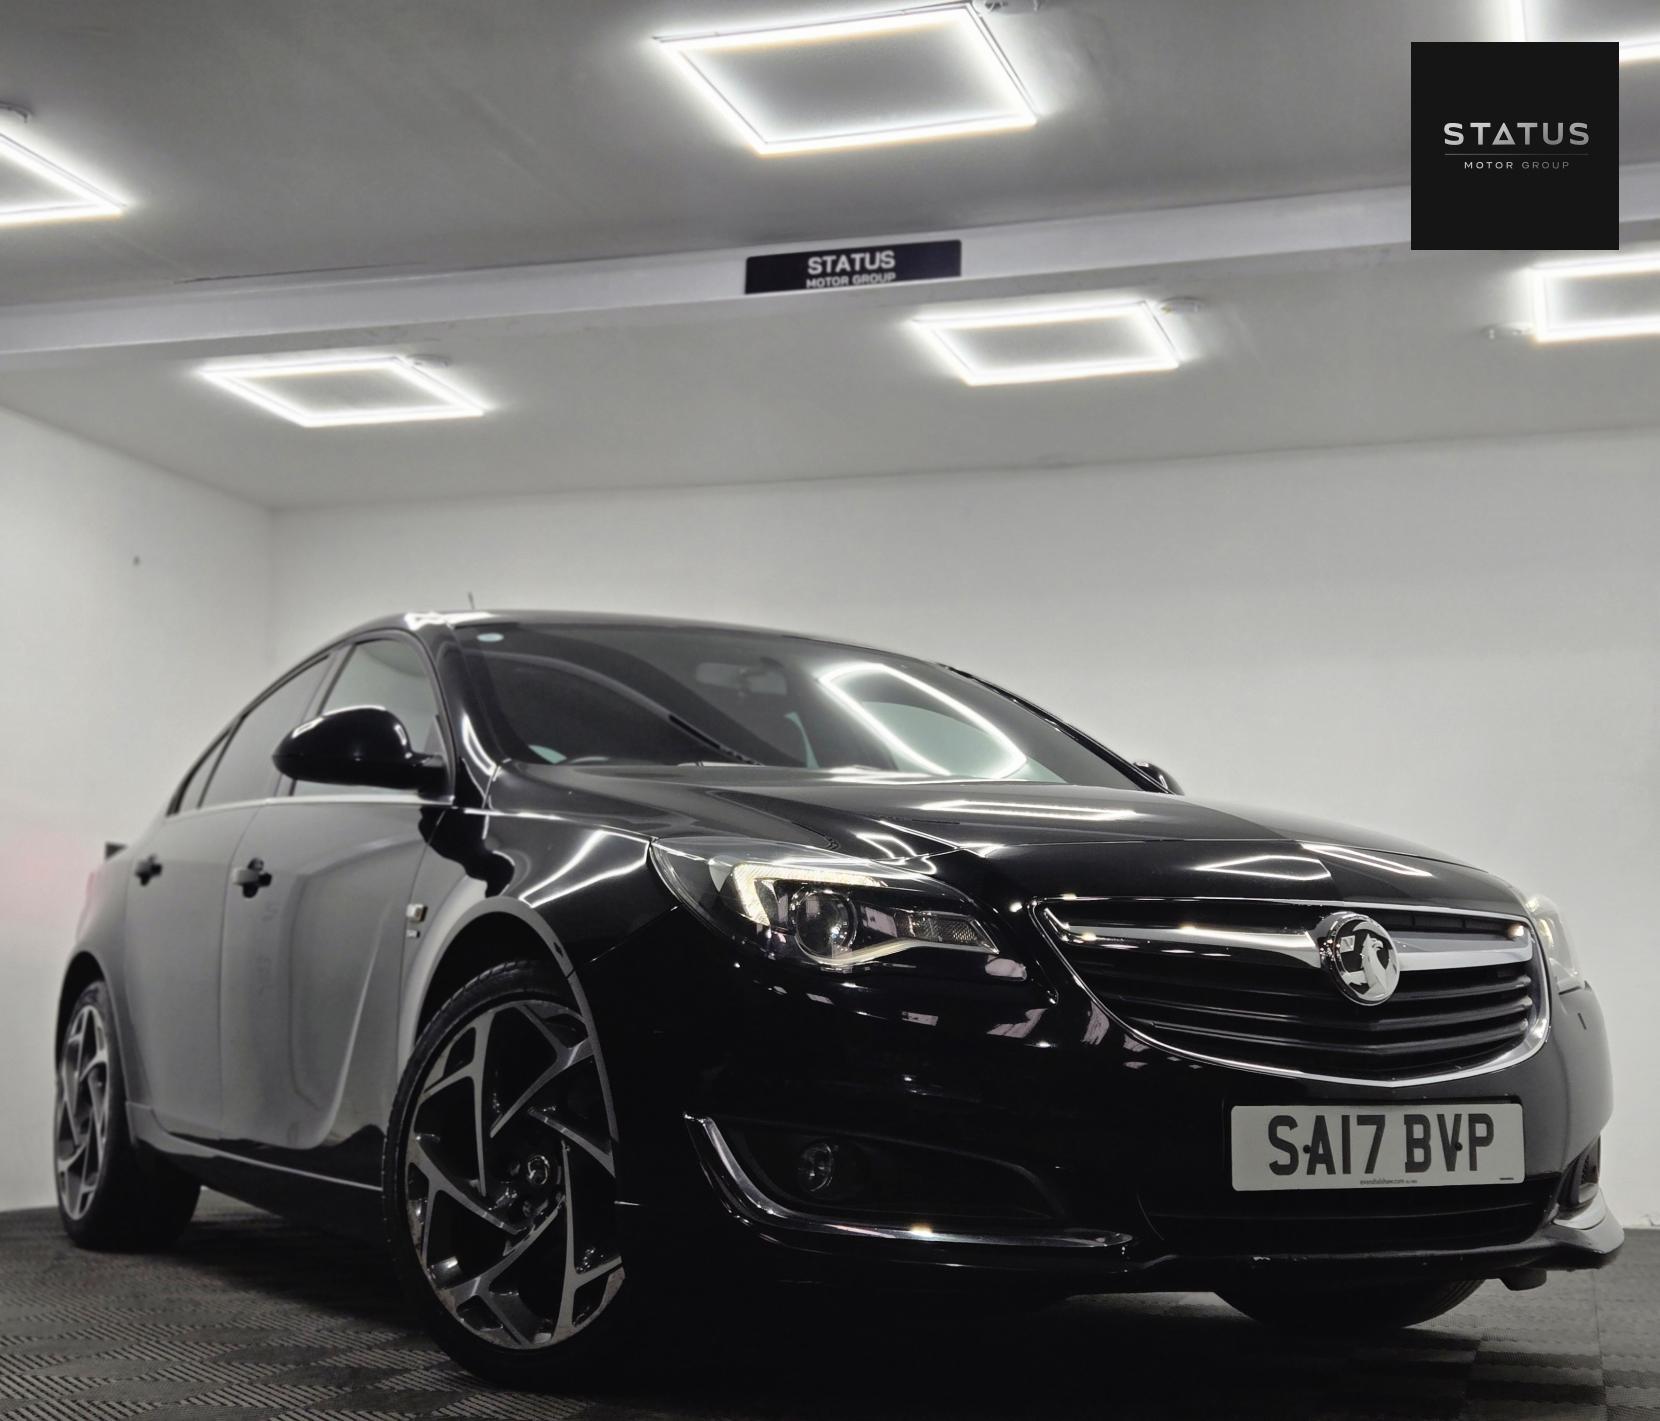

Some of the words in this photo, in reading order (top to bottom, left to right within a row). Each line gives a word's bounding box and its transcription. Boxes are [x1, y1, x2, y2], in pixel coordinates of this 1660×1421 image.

[808, 250, 895, 275] STATUS
[806, 276, 849, 289] MOTOR
[852, 272, 896, 286] GROUP
[1268, 1114, 1386, 1176] SA17
[1403, 1113, 1495, 1173] BVP
